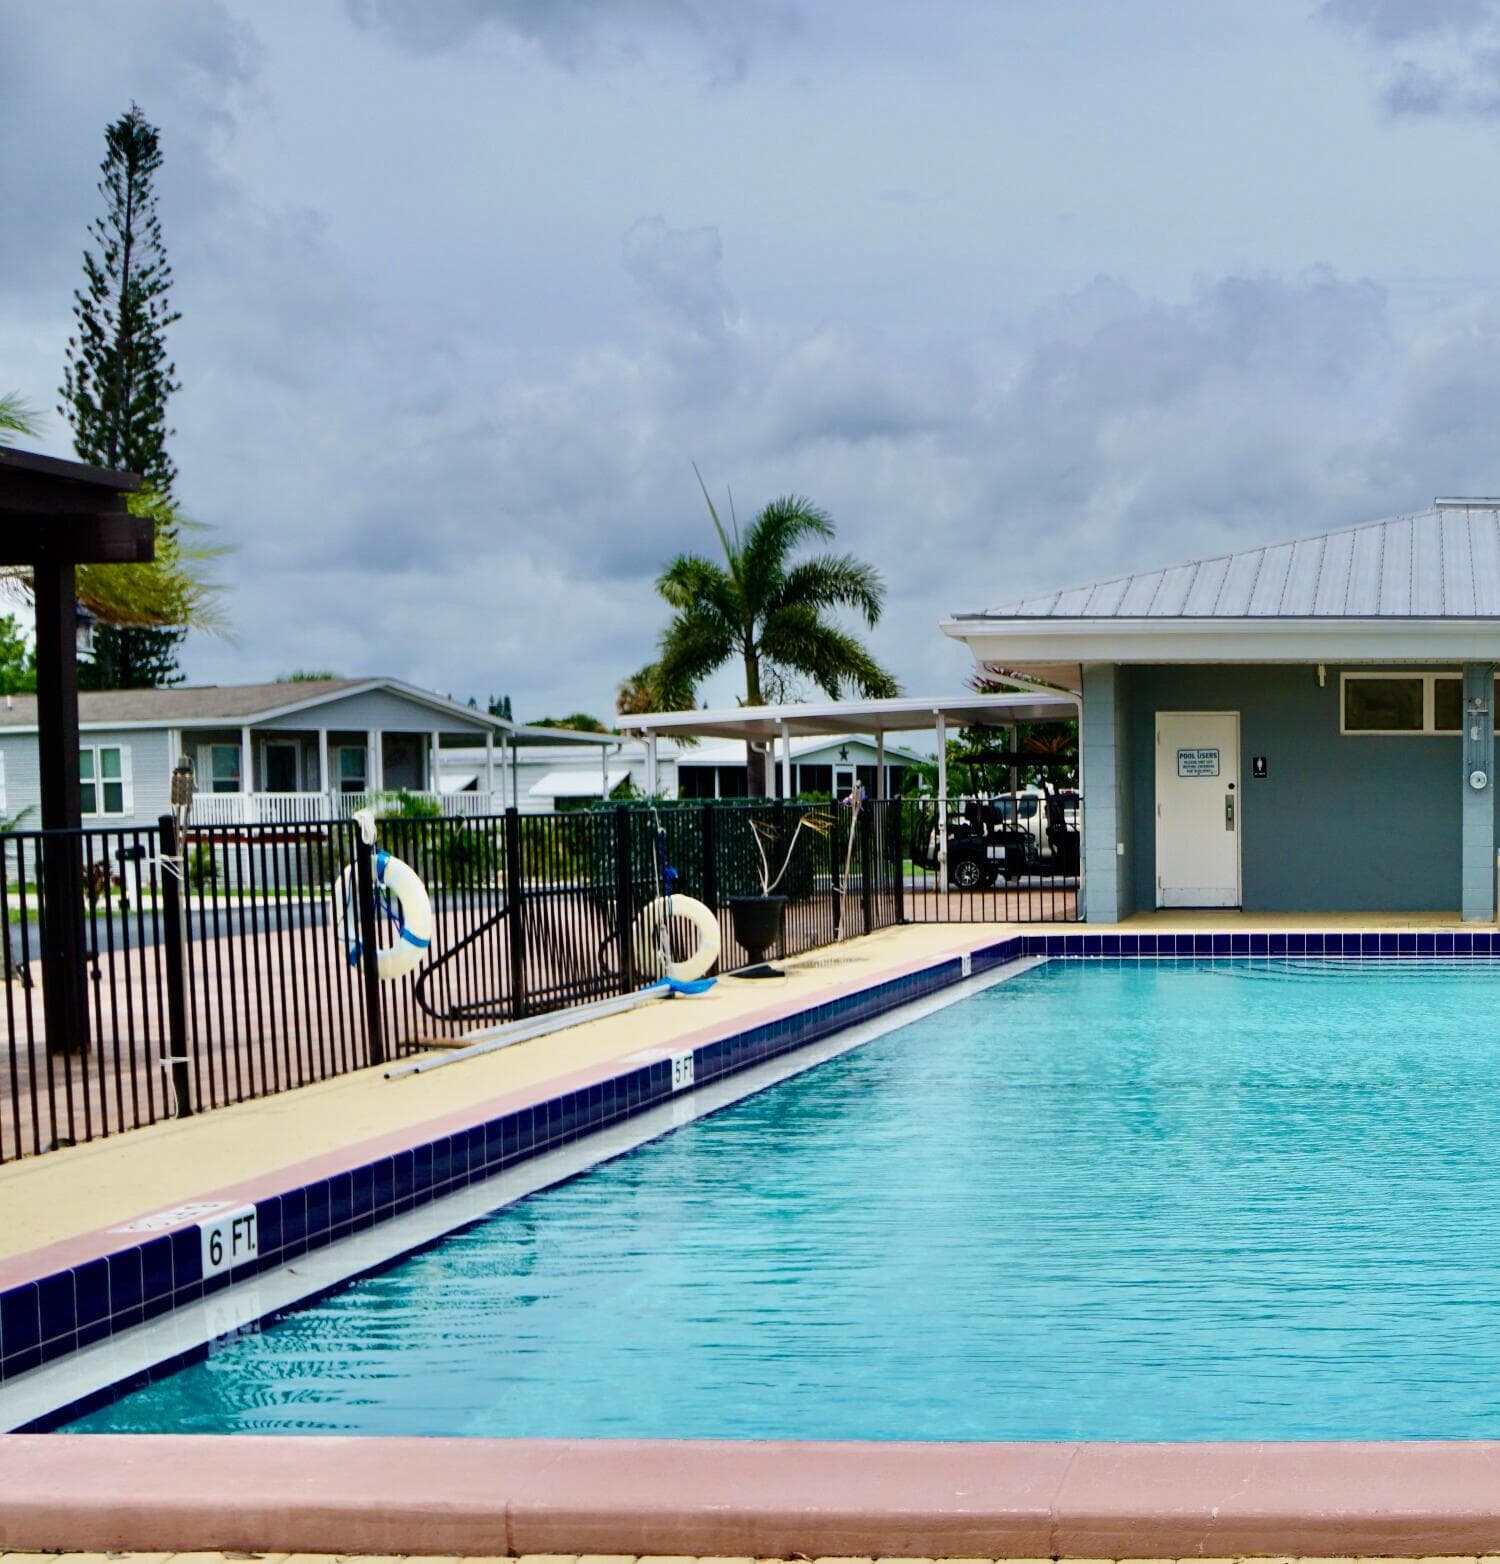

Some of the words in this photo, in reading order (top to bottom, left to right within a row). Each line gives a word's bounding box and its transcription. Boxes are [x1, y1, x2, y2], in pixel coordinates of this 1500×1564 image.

[676, 1061, 681, 1083] 5
[210, 1229, 223, 1266] 6
[232, 1214, 255, 1257] FT.
